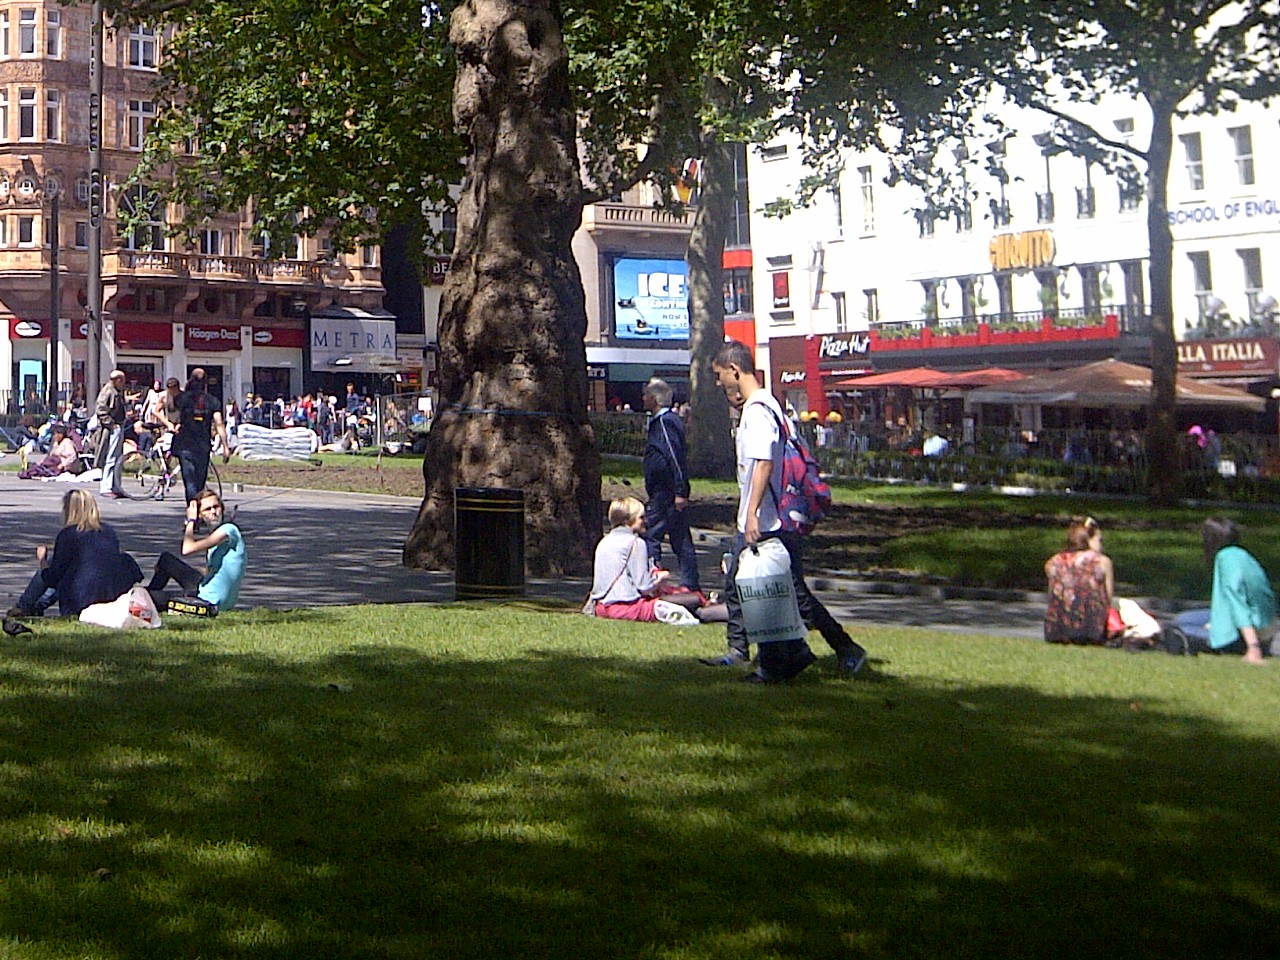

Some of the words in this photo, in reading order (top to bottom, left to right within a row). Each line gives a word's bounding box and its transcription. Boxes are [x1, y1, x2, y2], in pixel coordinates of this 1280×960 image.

[1168, 207, 1220, 225] SCHOOL
[1224, 203, 1240, 219] OF
[637, 271, 686, 298] ICE
[313, 330, 393, 349] METRA
[819, 335, 849, 358] Pizza
[848, 334, 871, 355] Hut
[1212, 342, 1264, 361] ITALIA
